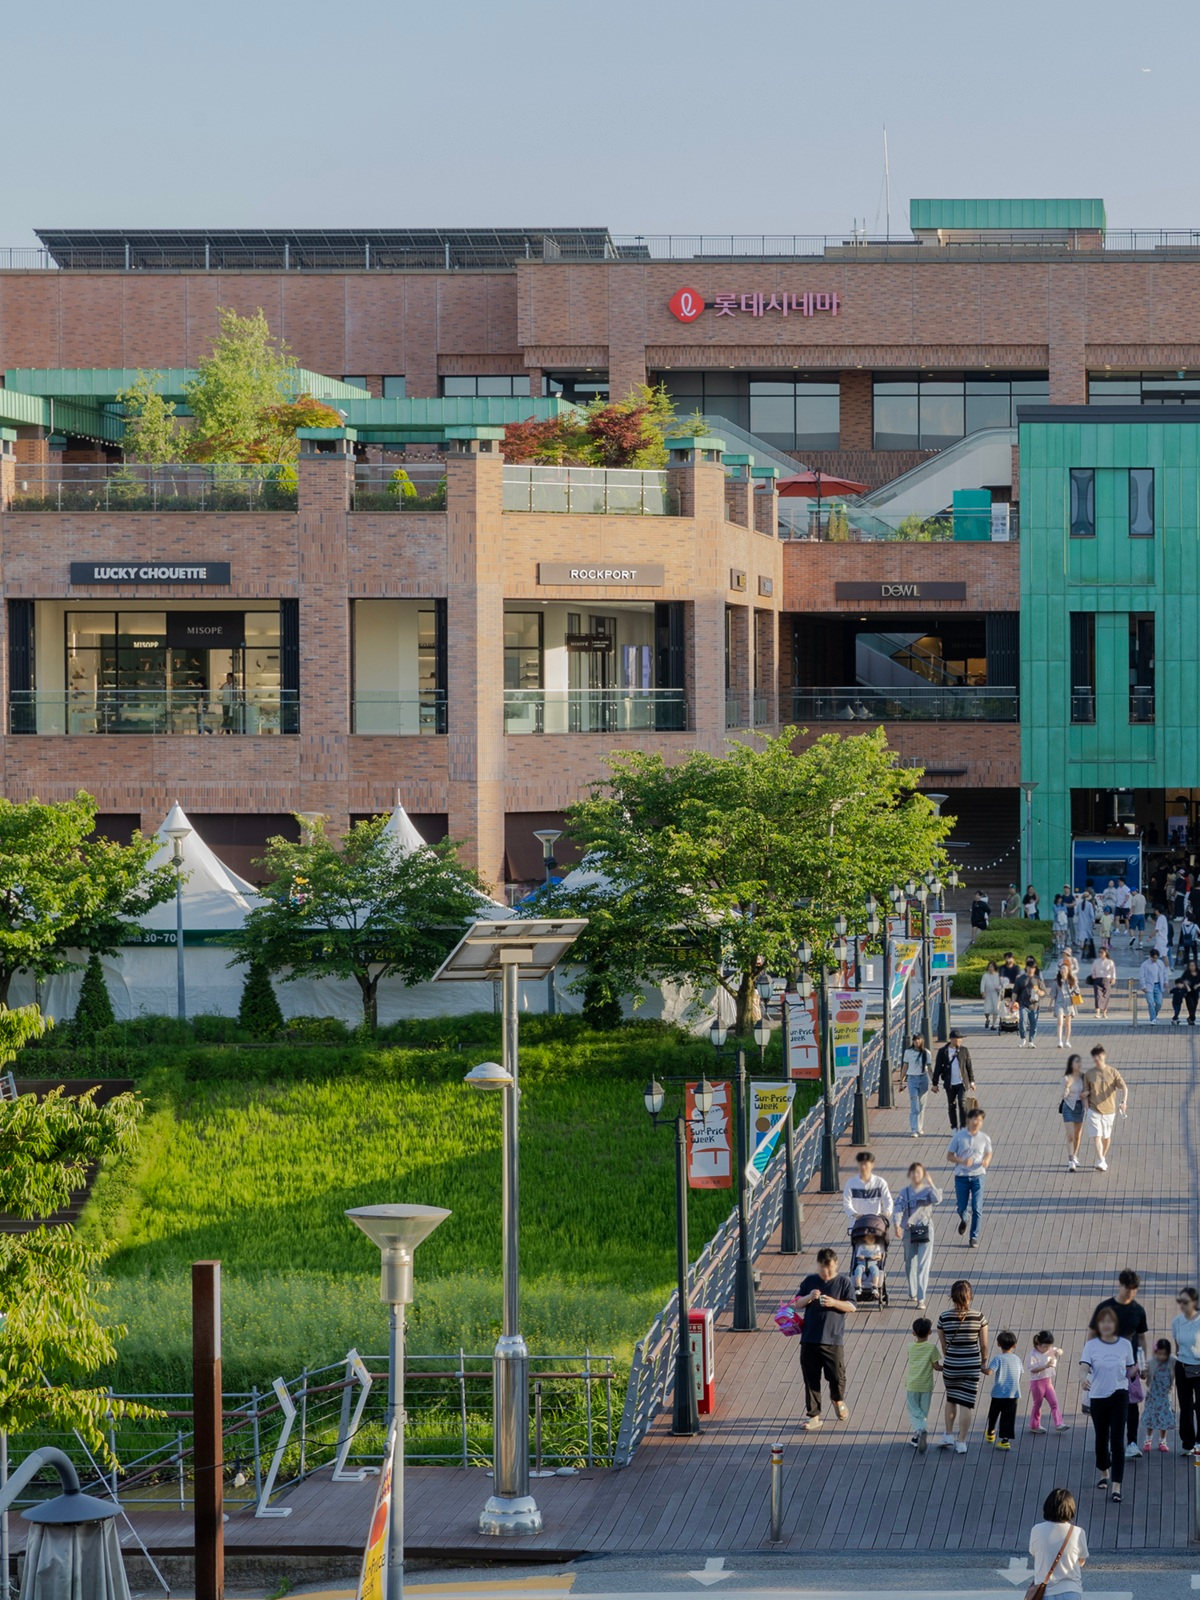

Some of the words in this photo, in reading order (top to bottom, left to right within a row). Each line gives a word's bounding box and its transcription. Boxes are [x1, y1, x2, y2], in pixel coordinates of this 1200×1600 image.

[714, 292, 841, 317] 롯데시네마
[94, 567, 138, 580] LUCKY
[139, 567, 207, 580] CHOUETTE
[569, 569, 637, 580] ROCKPORT
[144, 933, 177, 943] 30~70
[789, 1028, 817, 1036] ur-Price
